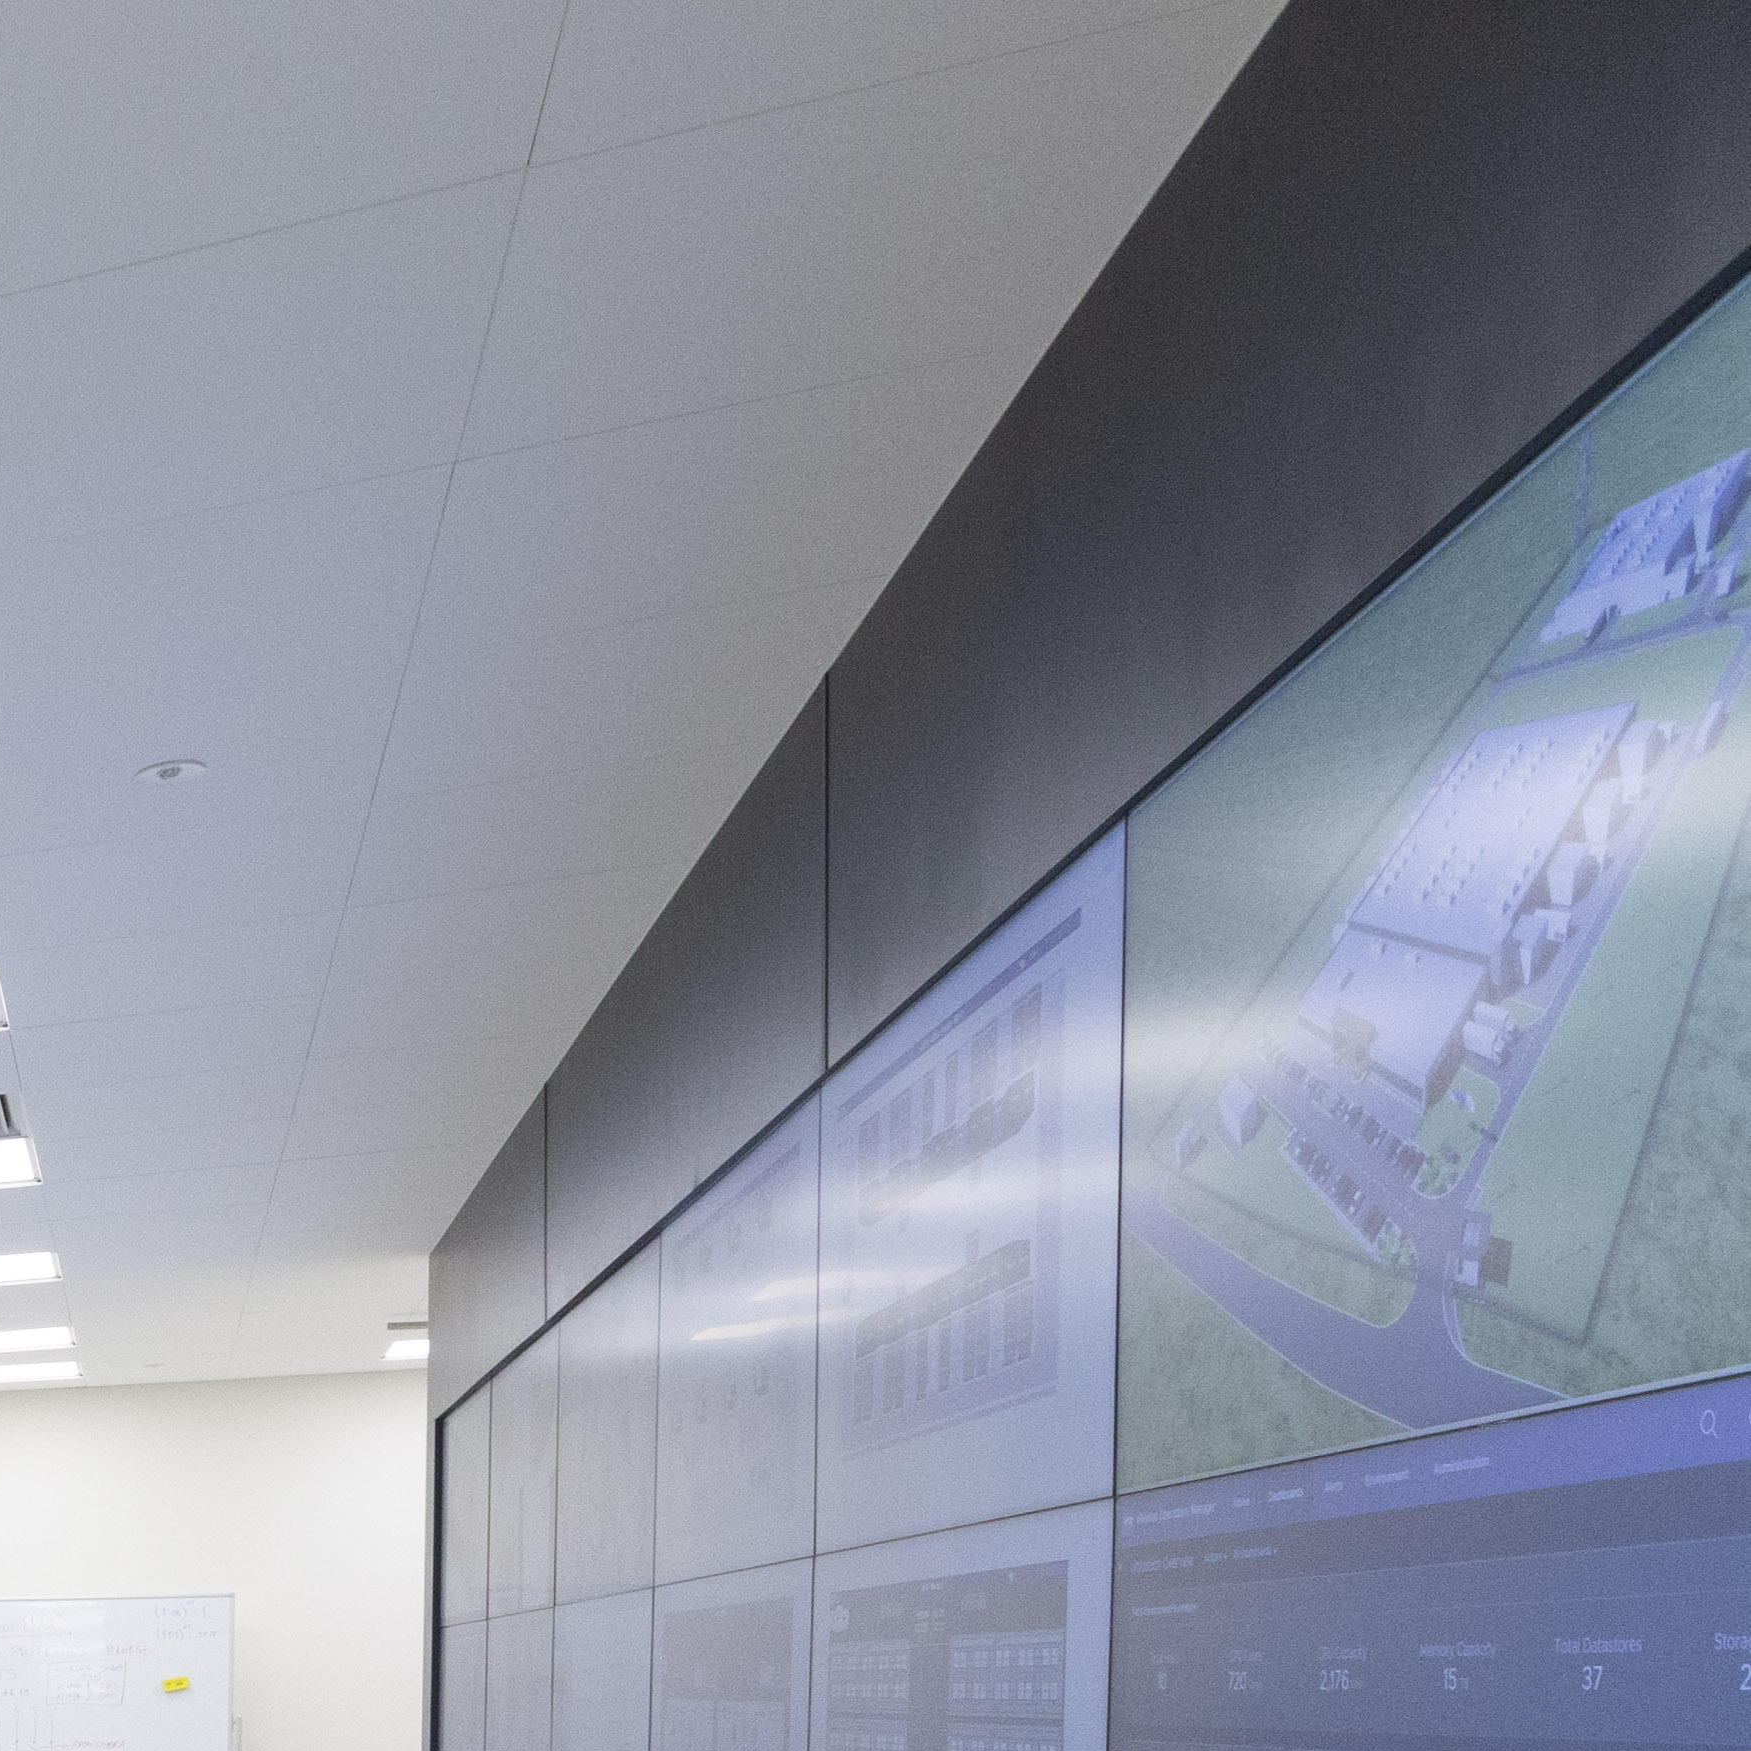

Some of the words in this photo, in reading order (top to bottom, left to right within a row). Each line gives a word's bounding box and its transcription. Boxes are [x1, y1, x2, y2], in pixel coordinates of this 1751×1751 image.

[1554, 1638, 1581, 1655] Total
[1583, 1636, 1643, 1655] Datastores
[1319, 1669, 1350, 1692] 2,176
[1443, 1666, 1457, 1690] 15
[1581, 1664, 1603, 1691] 37
